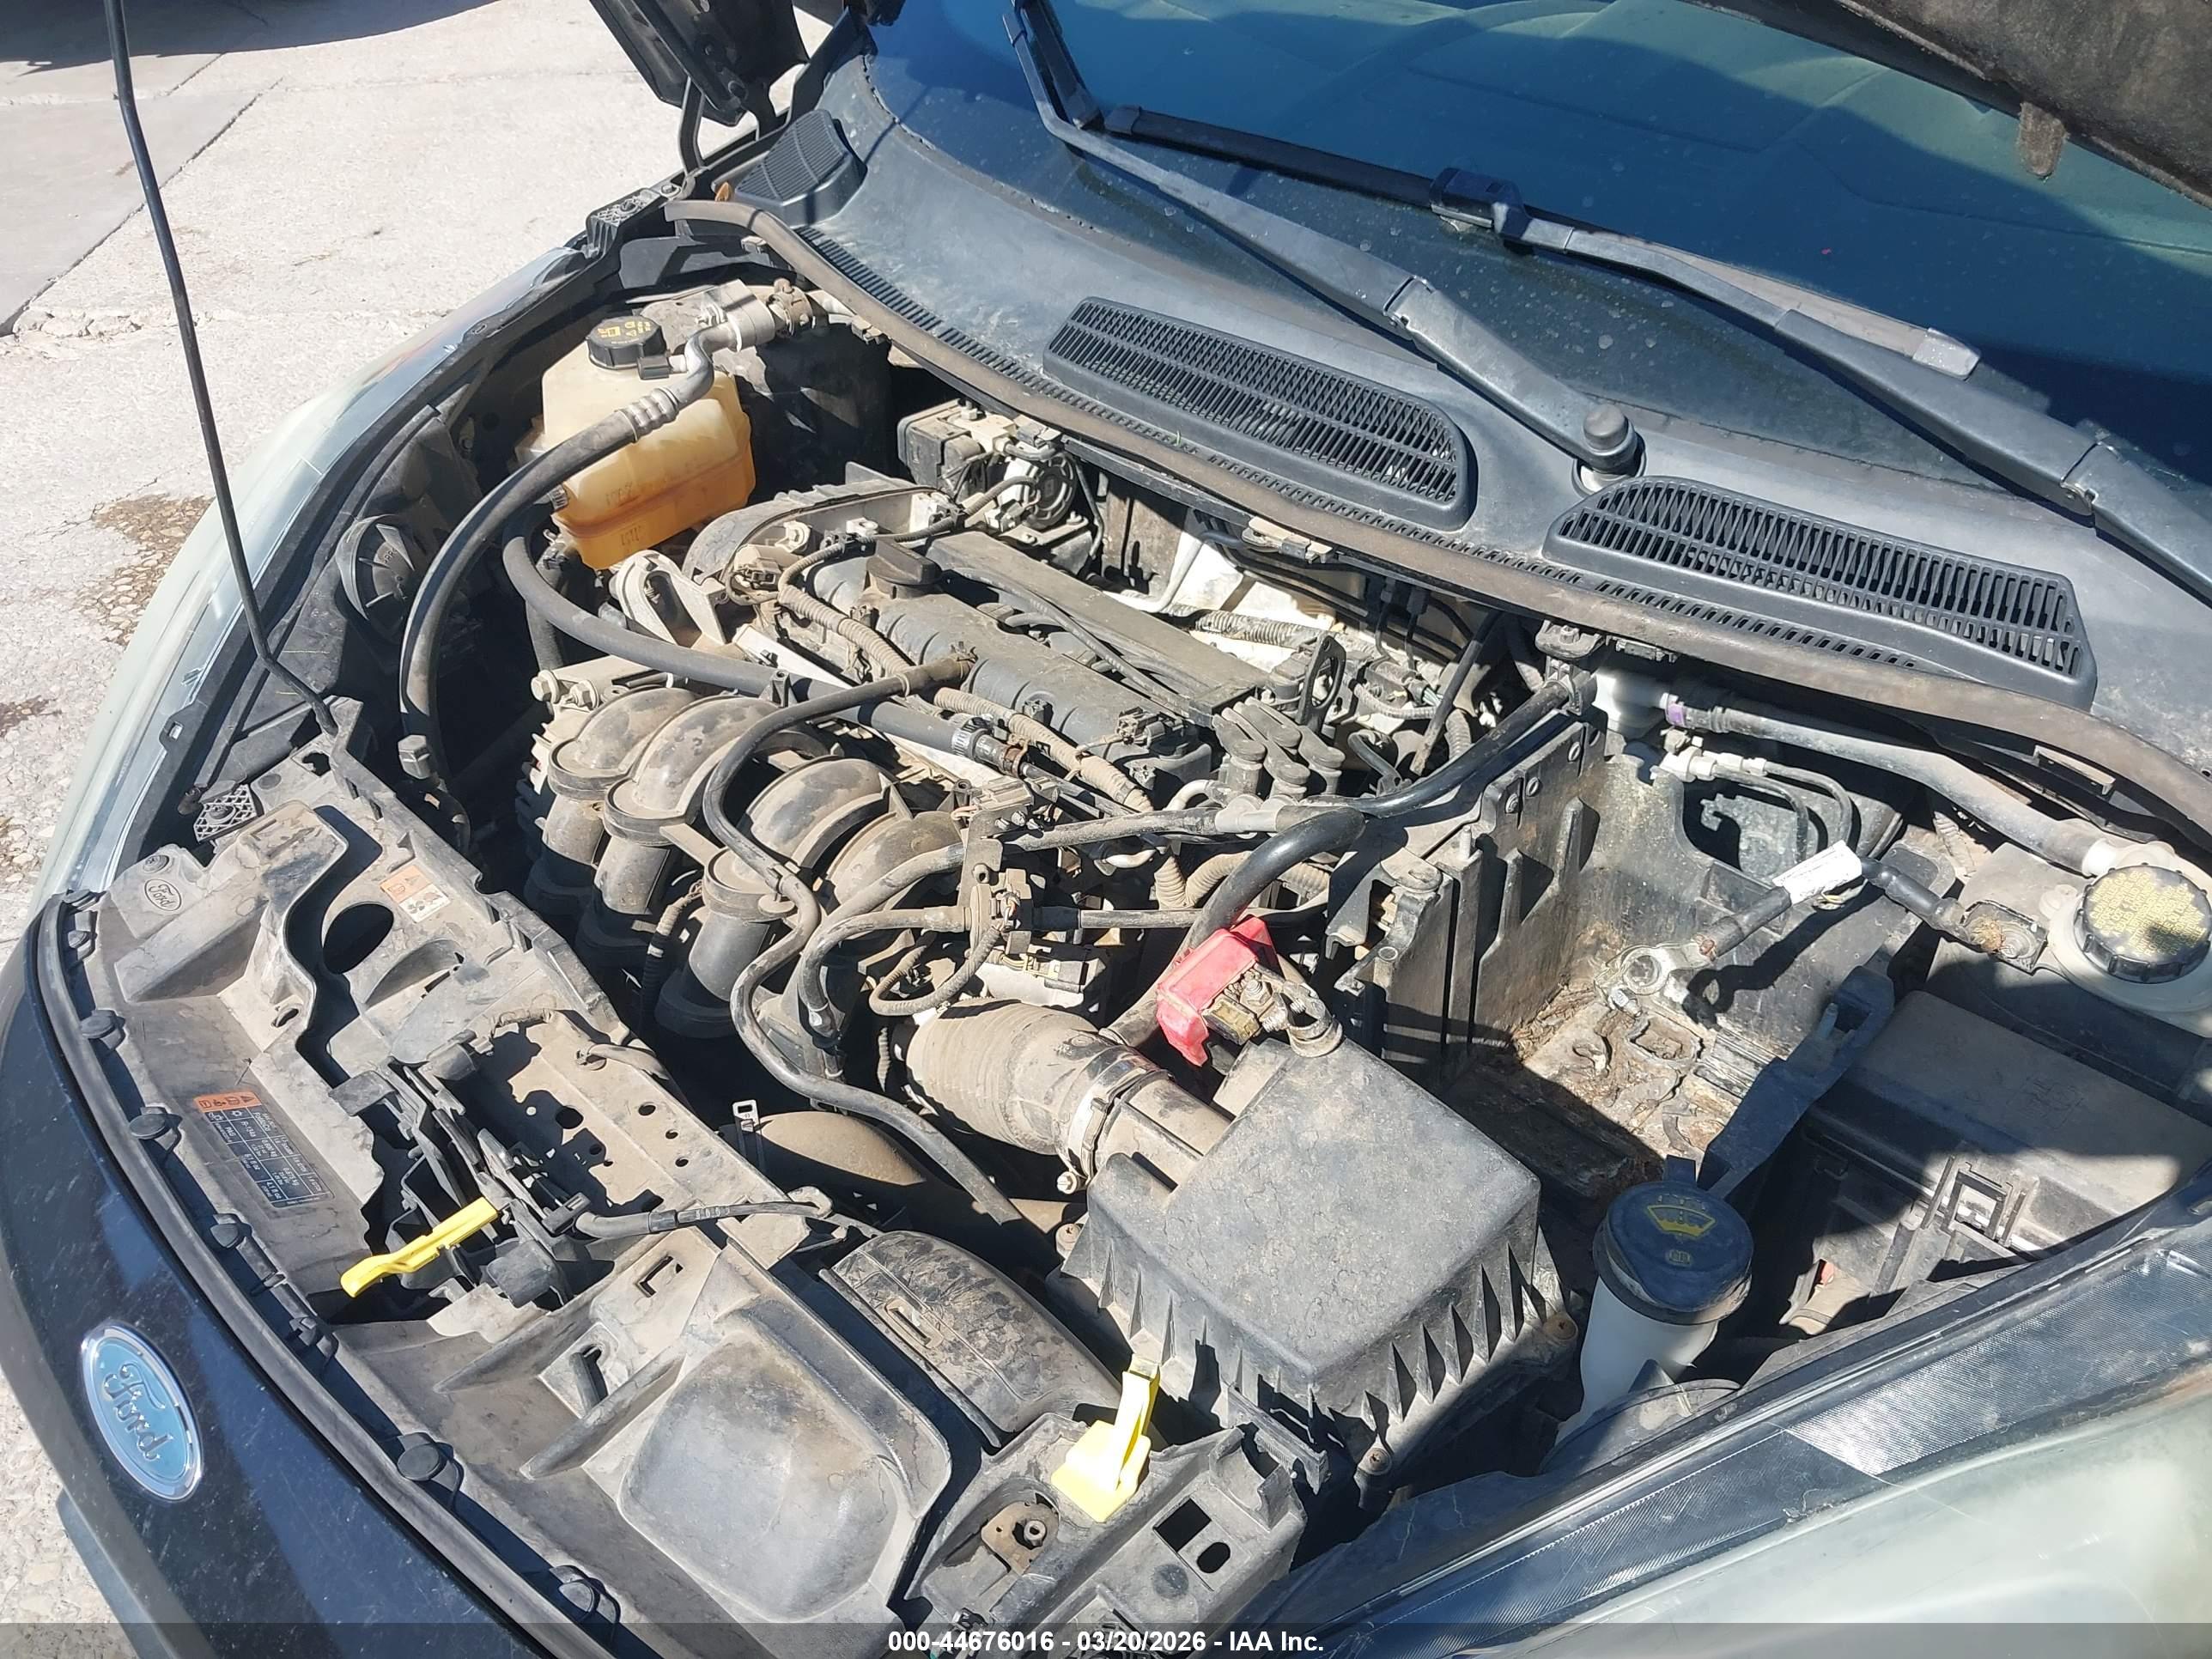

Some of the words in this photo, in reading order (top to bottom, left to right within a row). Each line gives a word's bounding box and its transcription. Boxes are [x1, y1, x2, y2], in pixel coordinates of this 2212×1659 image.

[148, 884, 177, 908] Ford
[225, 1126, 236, 1136] PAG
[242, 1121, 258, 1137] R-134a
[102, 1359, 173, 1462] Ford
